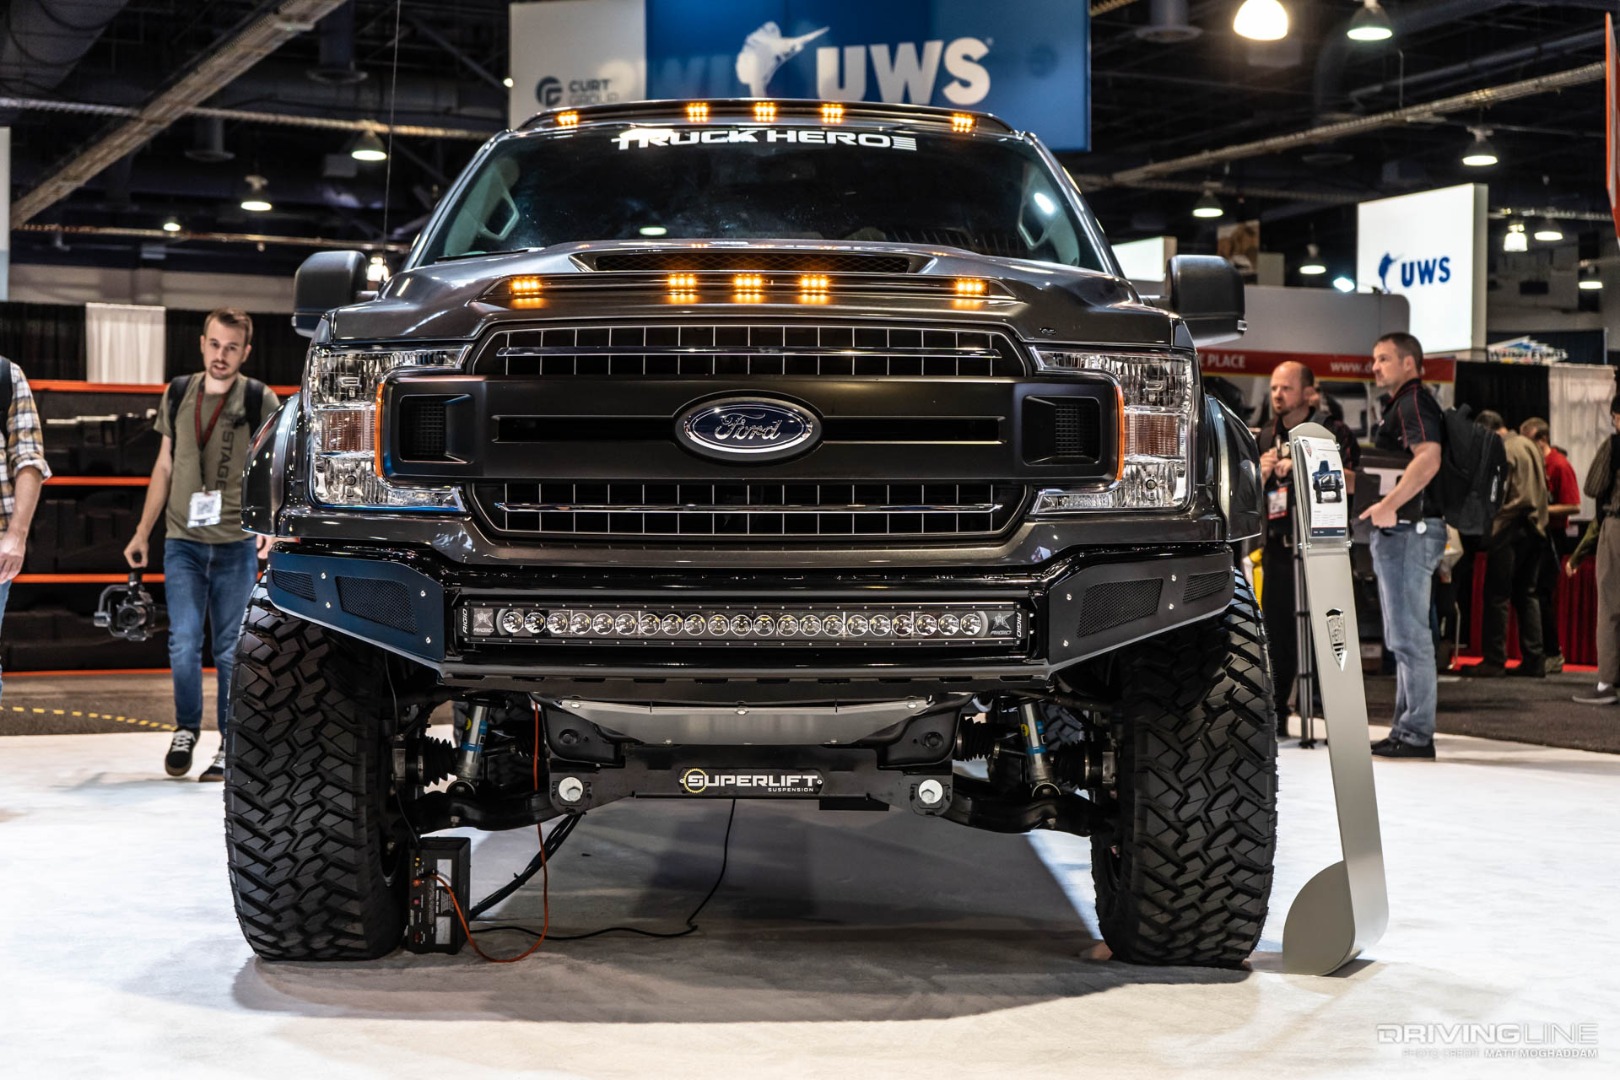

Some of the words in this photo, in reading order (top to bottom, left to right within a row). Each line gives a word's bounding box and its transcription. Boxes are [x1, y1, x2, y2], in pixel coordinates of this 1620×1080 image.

[817, 37, 991, 105] UWS
[568, 79, 610, 93] CURT
[611, 129, 760, 150] TRUCK
[1401, 256, 1451, 288] UWS
[1207, 354, 1246, 369] PLACE
[714, 412, 783, 440] Ford
[214, 430, 235, 491] STAGE
[687, 775, 818, 787] SUPERLIFT
